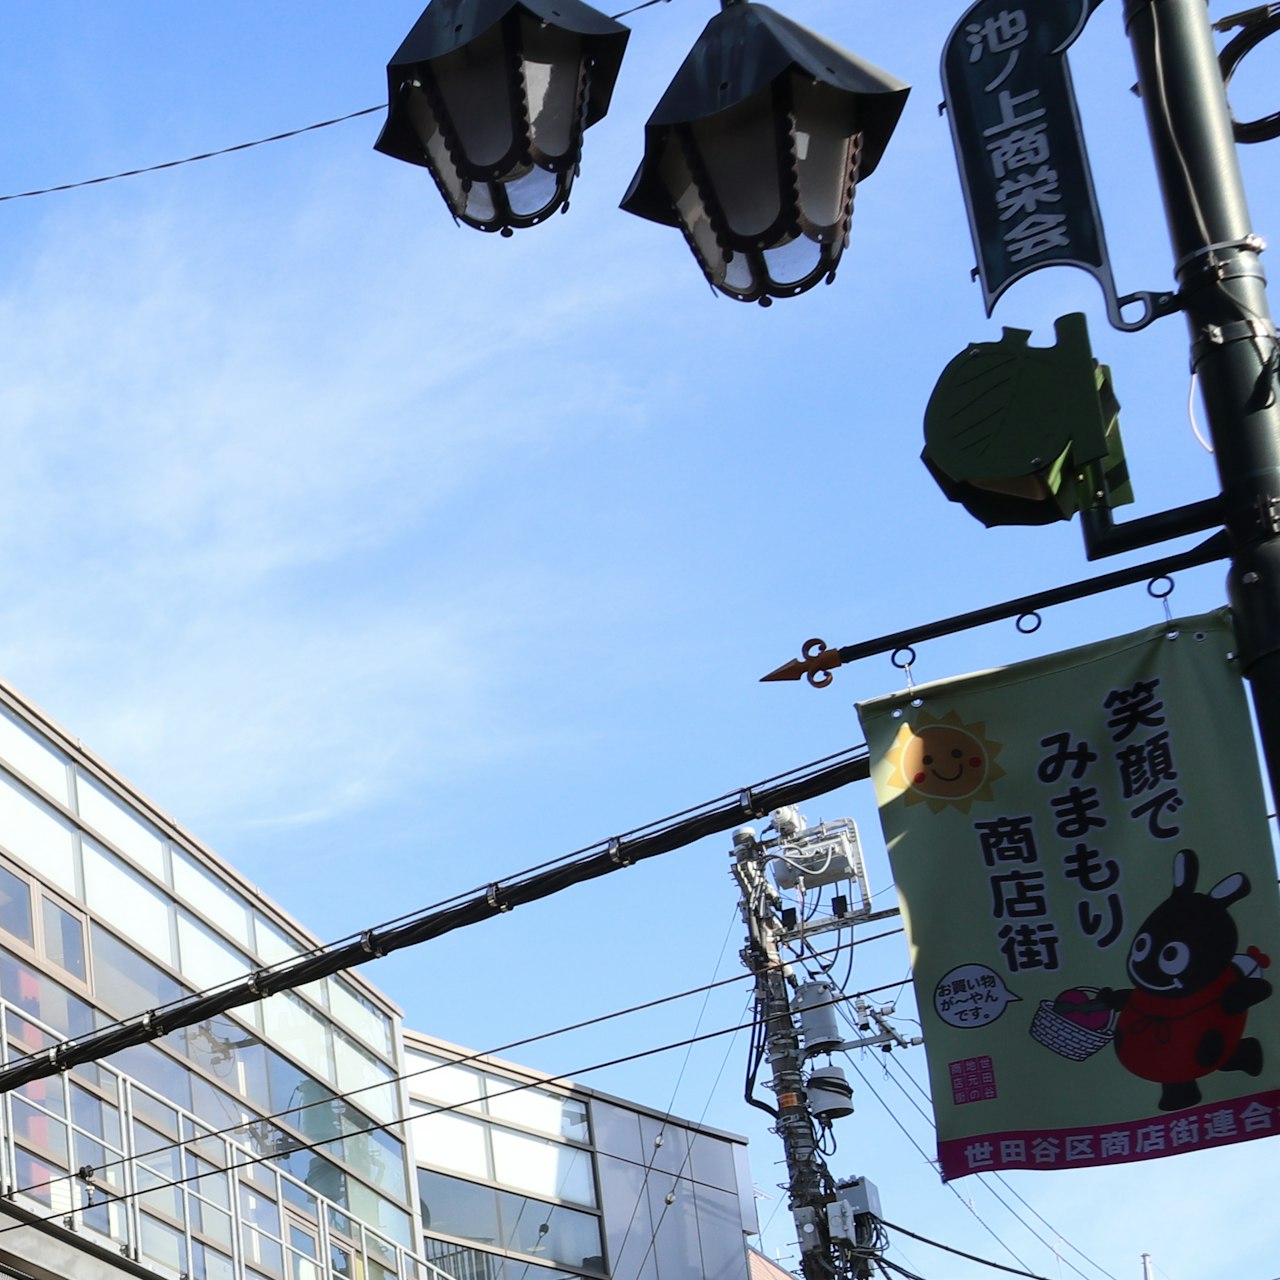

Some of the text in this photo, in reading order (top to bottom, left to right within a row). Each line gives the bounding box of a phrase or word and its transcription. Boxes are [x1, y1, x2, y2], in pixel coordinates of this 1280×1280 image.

[965, 9, 1071, 262] 池ノ上商栄会
[1101, 676, 1186, 840] 笑顔で
[973, 814, 1060, 974] 商店街
[1037, 731, 1126, 949] みまもり
[937, 975, 997, 998] お買い物
[954, 1006, 990, 1022] です。
[963, 1100, 1280, 1169] 世田谷区商店街連合
